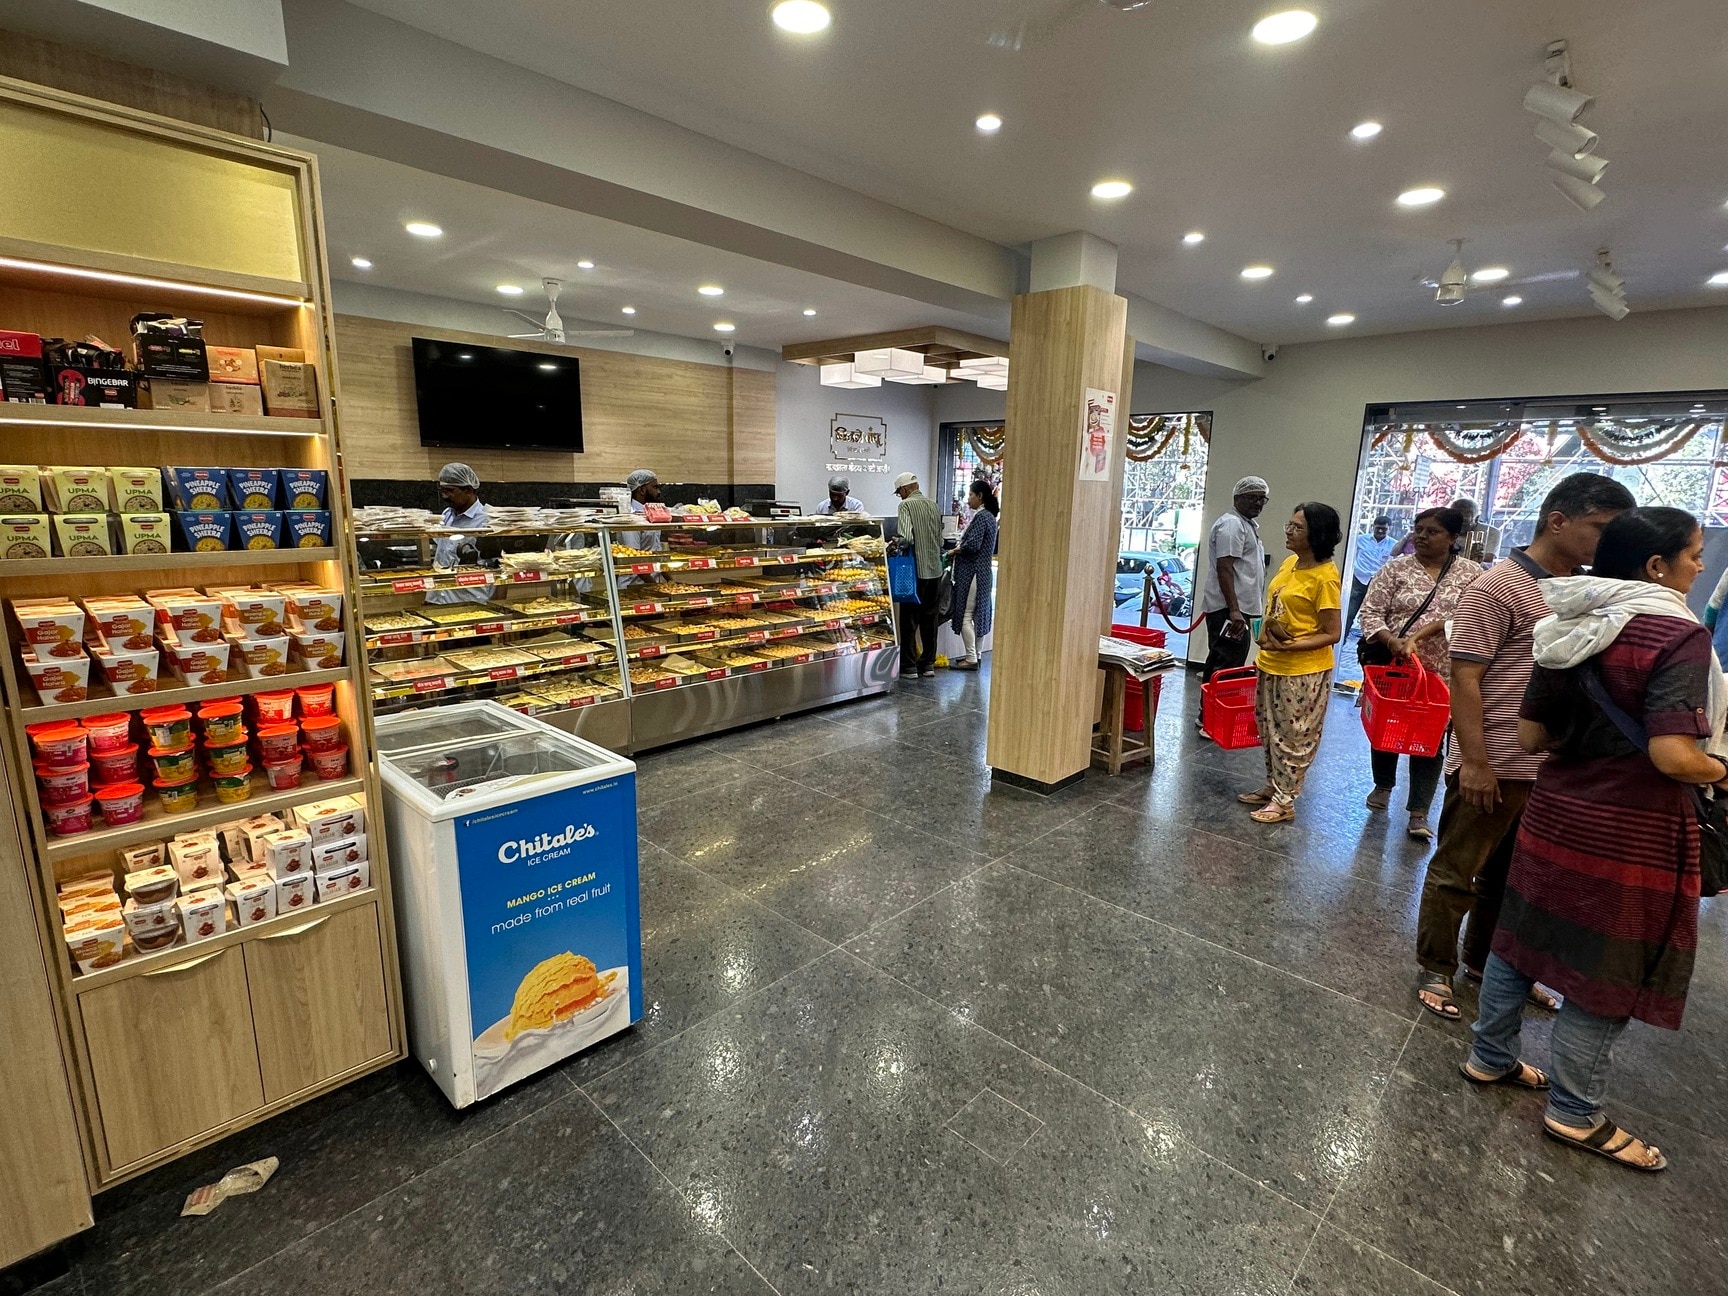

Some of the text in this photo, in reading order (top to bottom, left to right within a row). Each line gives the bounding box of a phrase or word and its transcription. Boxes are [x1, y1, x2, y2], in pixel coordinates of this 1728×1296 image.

[0, 339, 20, 350] el
[87, 377, 129, 387] BINGEBAR
[184, 480, 221, 490] PINEAPPLE
[238, 480, 273, 490] PINEAPPLE
[289, 480, 321, 490] PINEAPPLE
[68, 487, 98, 495] UPMA
[189, 486, 217, 495] SHEERA
[243, 486, 269, 495] SHEERA
[293, 486, 317, 495] SHEERA
[188, 523, 225, 533] PINEAPPLE
[242, 522, 277, 532] PINEAPPLE
[294, 521, 325, 531] PINEAPPLE
[134, 532, 162, 540] UPMA
[193, 529, 221, 539] SHEERA
[246, 529, 273, 538] SHEERA
[298, 527, 322, 536] SHEERA
[181, 616, 200, 624] Gajar
[111, 622, 131, 630] Gajar
[42, 675, 64, 683] Gajar
[582, 781, 619, 795] www.chitales.in
[498, 824, 596, 864] Chitale's
[527, 848, 571, 867] ICE CREAM
[507, 872, 596, 909] MANGO ICE CREAM
[491, 883, 611, 935] made from real fruit
